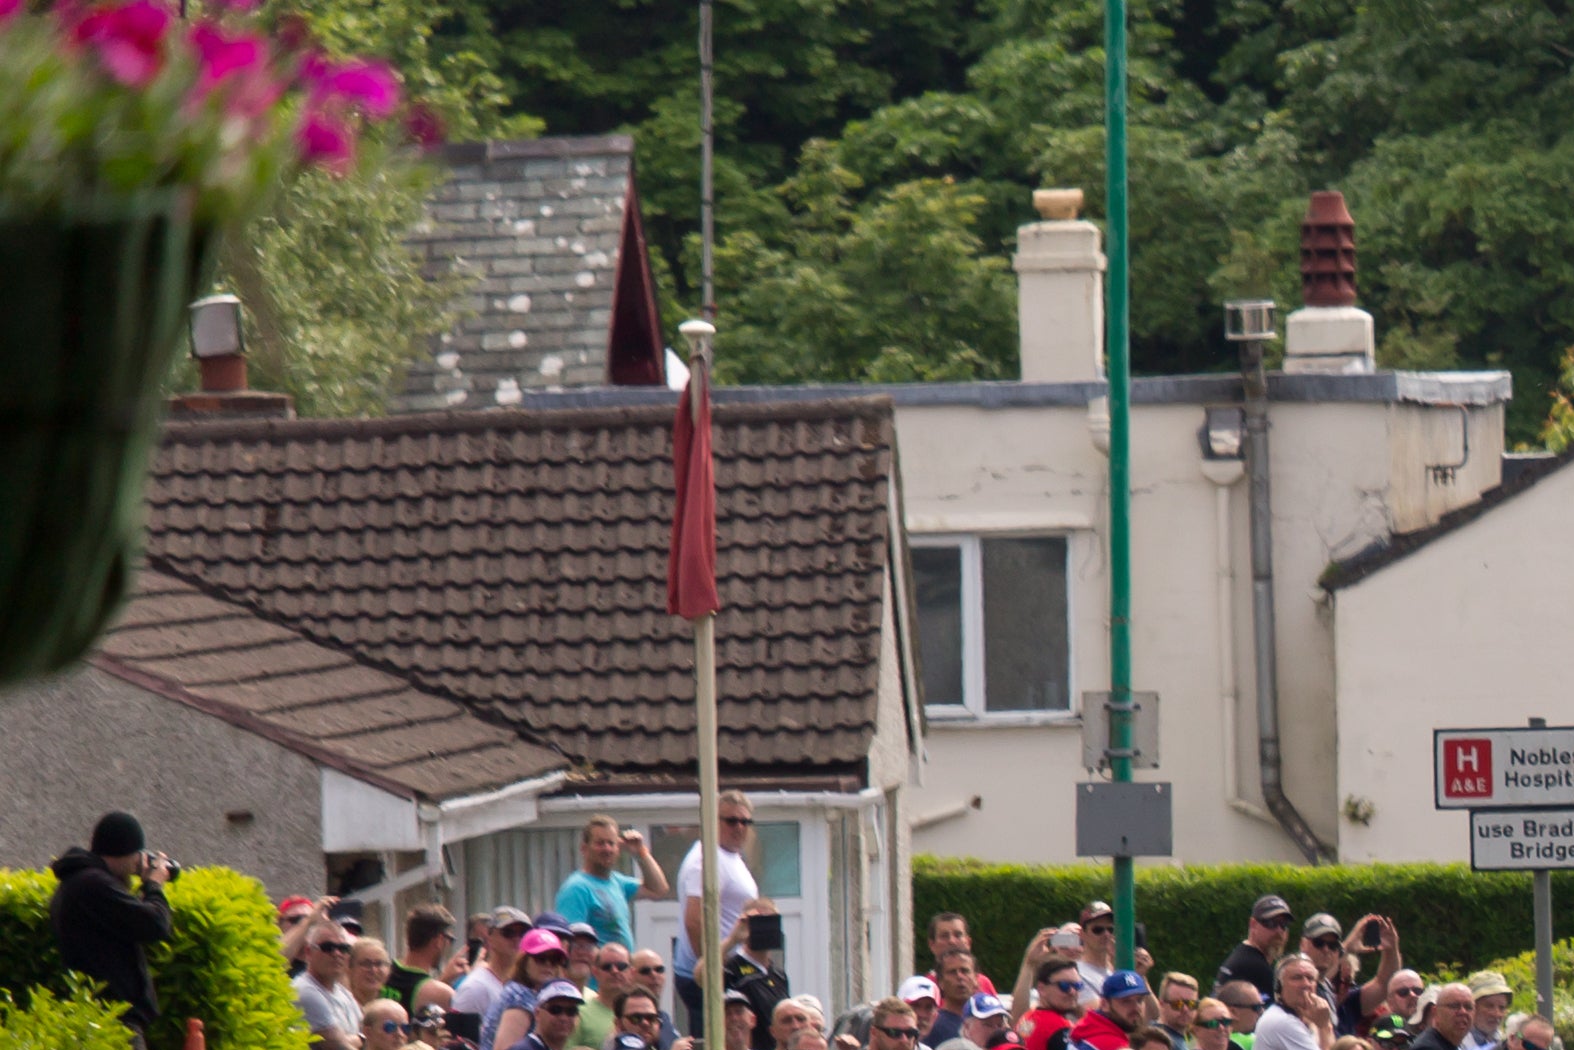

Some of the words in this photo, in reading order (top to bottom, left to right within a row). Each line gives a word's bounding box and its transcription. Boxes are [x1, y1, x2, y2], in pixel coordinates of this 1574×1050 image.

[1456, 745, 1479, 773] H
[1451, 778, 1488, 793] A&E
[1478, 824, 1514, 839] use
